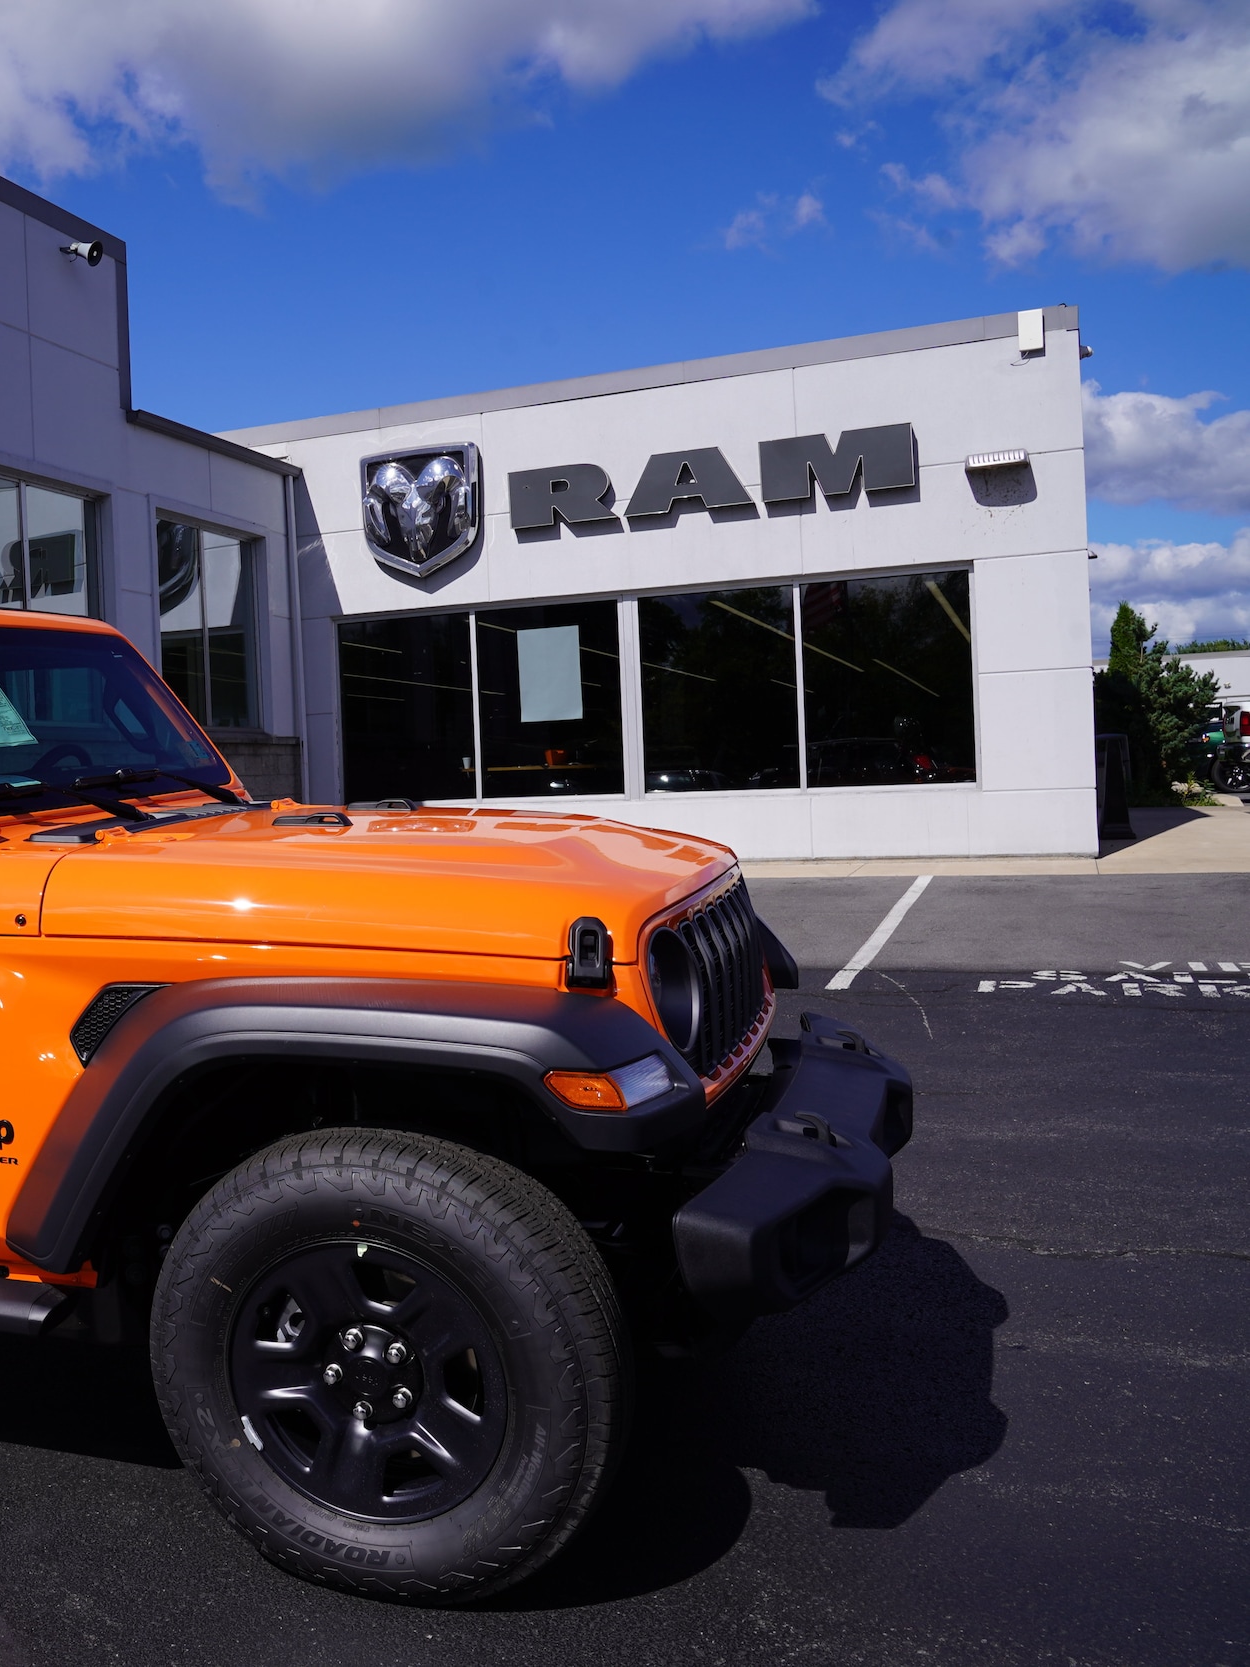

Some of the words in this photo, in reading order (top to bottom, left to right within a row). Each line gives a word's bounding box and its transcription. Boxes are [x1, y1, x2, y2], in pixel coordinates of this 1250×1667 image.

[508, 422, 918, 532] RAM
[1031, 970, 1250, 984] SAL
[250, 1493, 391, 1567] ROADIAN
